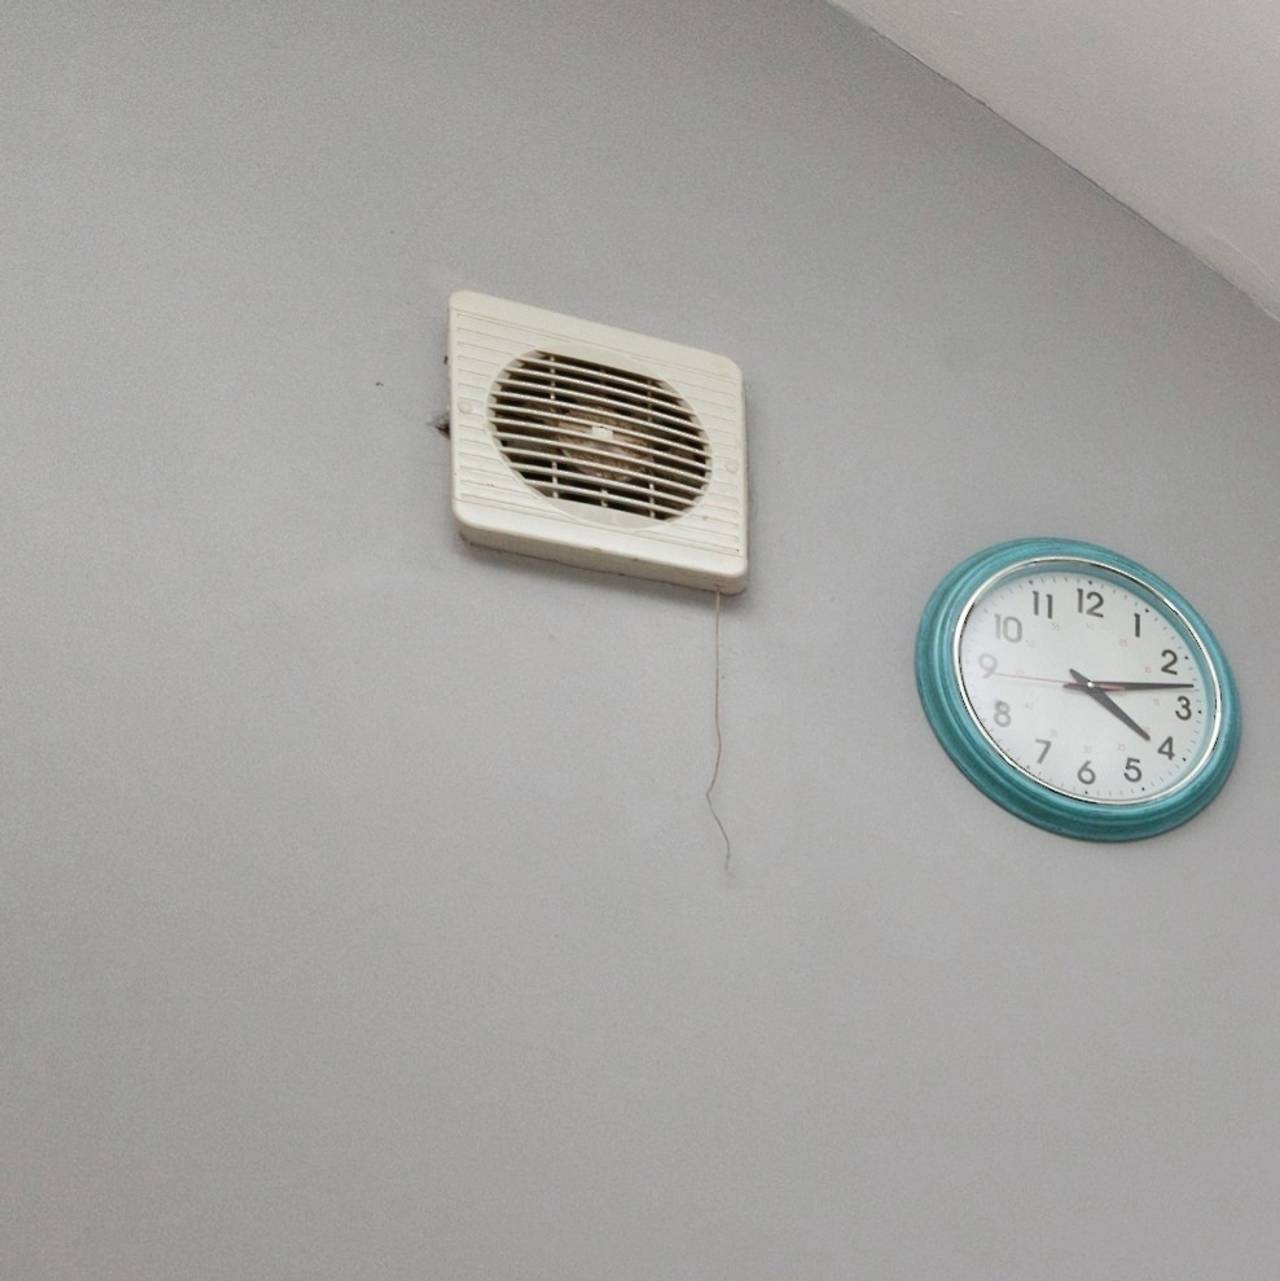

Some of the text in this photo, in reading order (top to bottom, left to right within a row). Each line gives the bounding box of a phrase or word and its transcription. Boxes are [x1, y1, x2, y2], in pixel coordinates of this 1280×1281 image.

[1032, 590, 1054, 620] 11
[1077, 588, 1104, 619] 12
[993, 613, 1023, 644] 10
[1133, 612, 1142, 638] 1
[977, 652, 999, 679] 9
[1160, 649, 1178, 675] 2
[992, 698, 1012, 728] 8
[1174, 695, 1192, 721] 3
[1034, 737, 1053, 764] 7
[1157, 735, 1176, 761] 4
[1077, 759, 1096, 785] 6
[1123, 757, 1143, 783] 5
